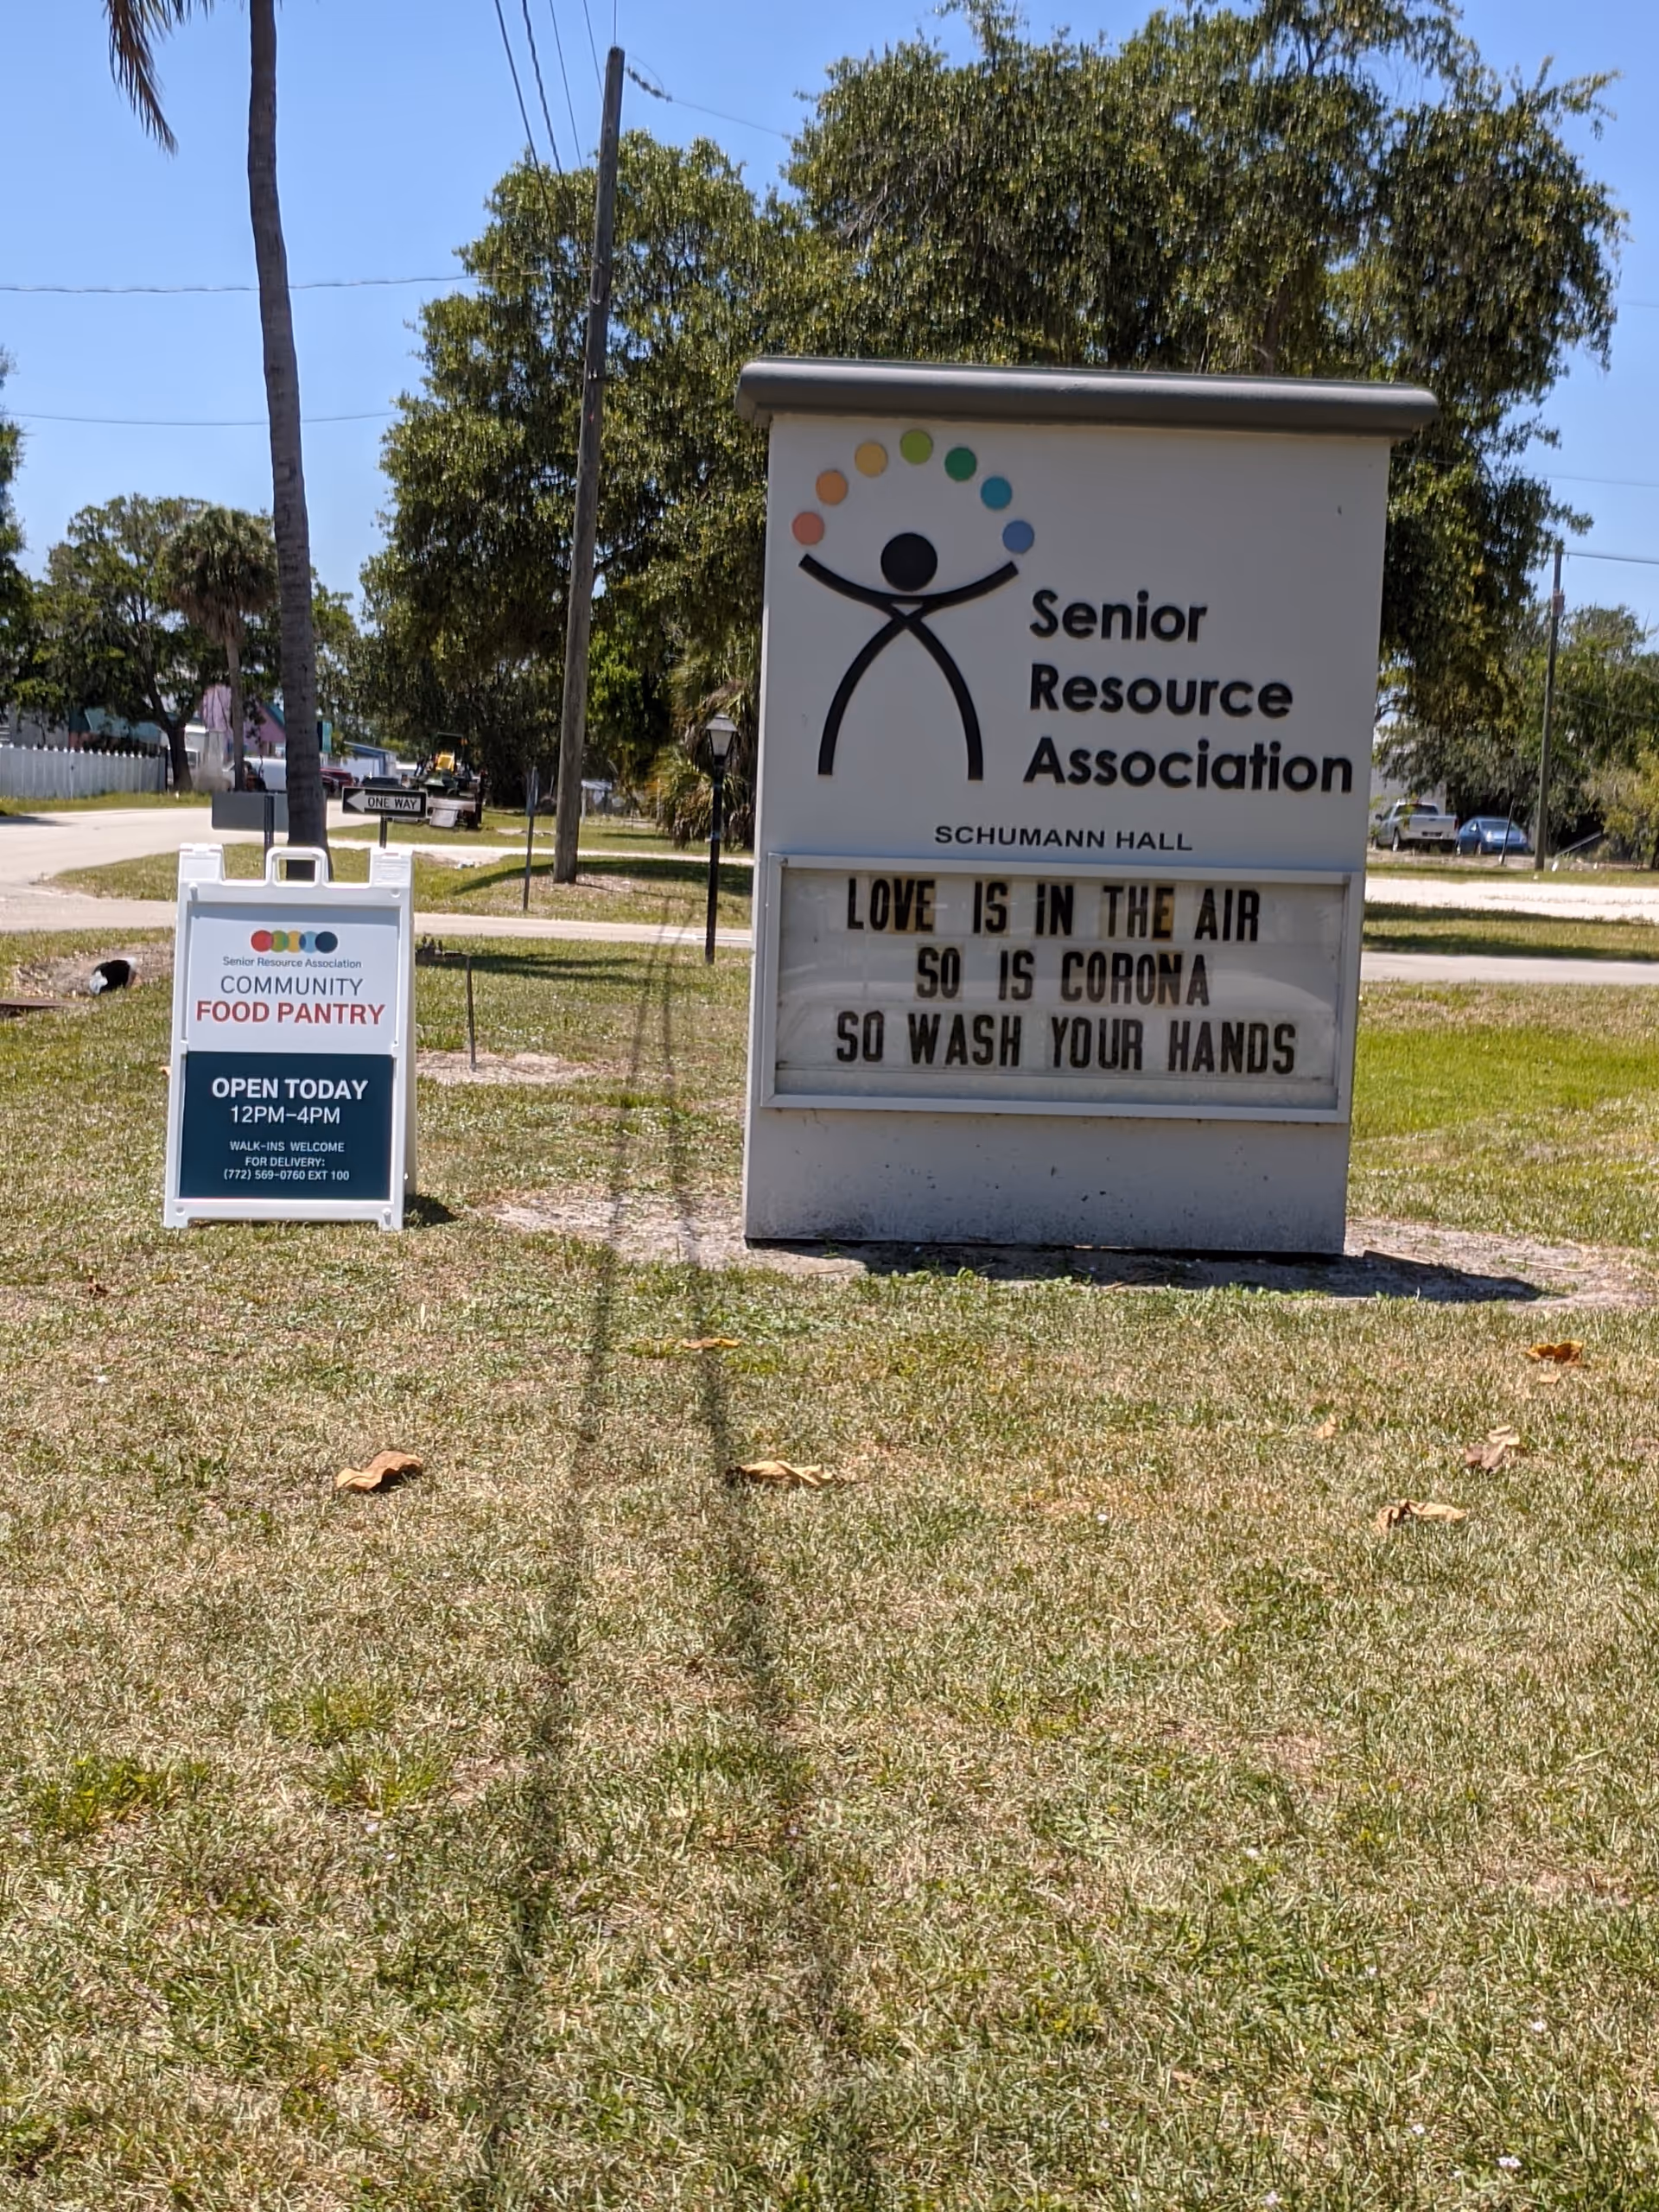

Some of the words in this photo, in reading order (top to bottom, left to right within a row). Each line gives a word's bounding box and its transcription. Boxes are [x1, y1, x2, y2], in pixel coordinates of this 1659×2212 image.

[1029, 588, 1208, 643] Senior
[1029, 663, 1294, 719] Resource
[1023, 736, 1353, 793] Association
[367, 795, 389, 808] ONE
[394, 796, 416, 810] WAY
[934, 825, 1105, 849] SCHUMANN
[1116, 830, 1193, 851] HALL
[847, 877, 936, 932] LOVE
[972, 880, 1009, 934] IS
[1035, 880, 1075, 937] IN
[1102, 884, 1175, 939] THE
[1193, 887, 1261, 942] AIR
[222, 956, 255, 967] Senior
[257, 957, 303, 968] Resource
[304, 958, 362, 969] Association
[220, 975, 364, 996] COMMUNITY
[917, 946, 961, 999] SO
[998, 949, 1035, 1001] IS
[1060, 950, 1210, 1007] CORONA
[196, 1000, 270, 1023] FOOD
[277, 1001, 385, 1025] PANTRY
[836, 1009, 885, 1063] SO
[907, 1013, 1023, 1067] WASH
[1051, 1016, 1143, 1071] YOUR
[1167, 1020, 1297, 1076] HANDS
[212, 1077, 278, 1099] OPEN
[283, 1078, 369, 1100] TODAY
[230, 1104, 340, 1124] 12PM-4PM
[229, 1141, 285, 1152] WALK-INS
[289, 1141, 345, 1153] WELCOME
[245, 1156, 268, 1166] FOR
[270, 1157, 326, 1167] DELIVERY:
[223, 1169, 251, 1180] (772)
[254, 1170, 306, 1180] 569-0760
[308, 1171, 328, 1181] EXT
[330, 1171, 350, 1181] 100
